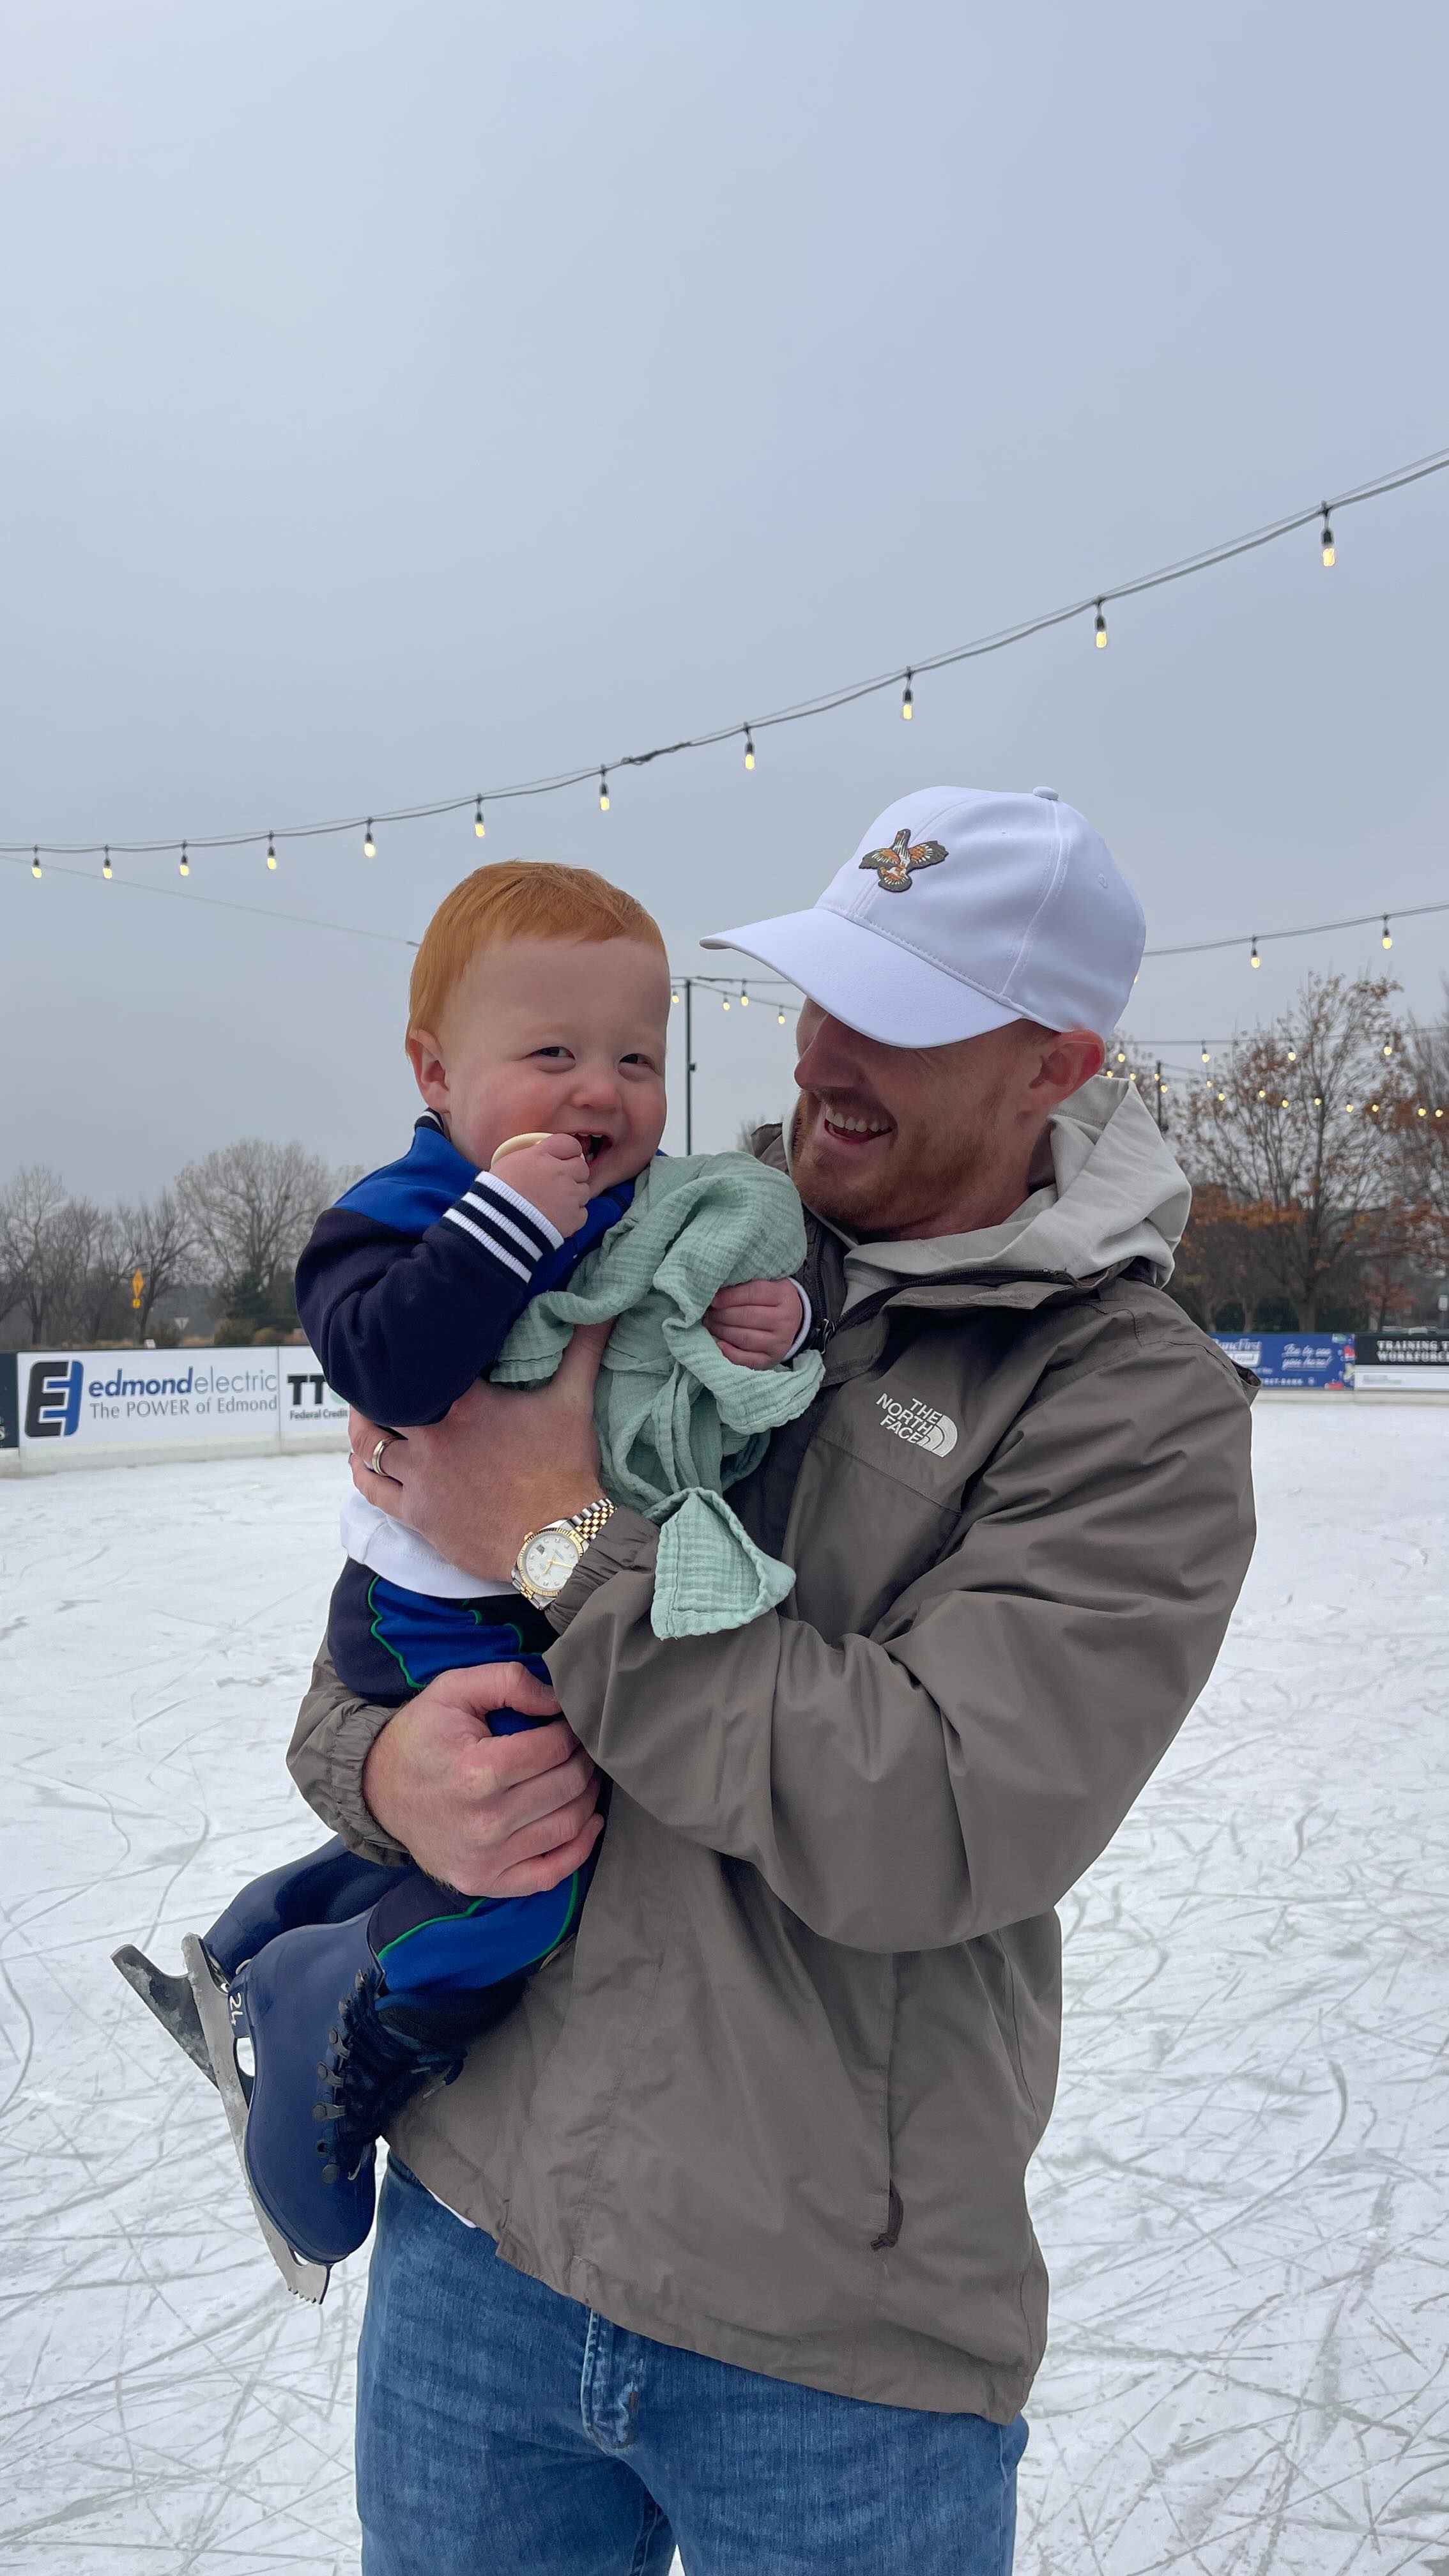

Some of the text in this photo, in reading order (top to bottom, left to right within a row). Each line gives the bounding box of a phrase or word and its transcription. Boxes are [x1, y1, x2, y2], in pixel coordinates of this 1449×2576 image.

[1377, 1340, 1438, 1351] TRAINING
[89, 1394, 277, 1419] The POWER of Edmond
[289, 1407, 348, 1420] Federal Credit
[876, 1393, 933, 1435] NORTH
[910, 1398, 942, 1425] THE
[880, 1414, 923, 1444] FACE
[230, 1992, 243, 2026] 24
